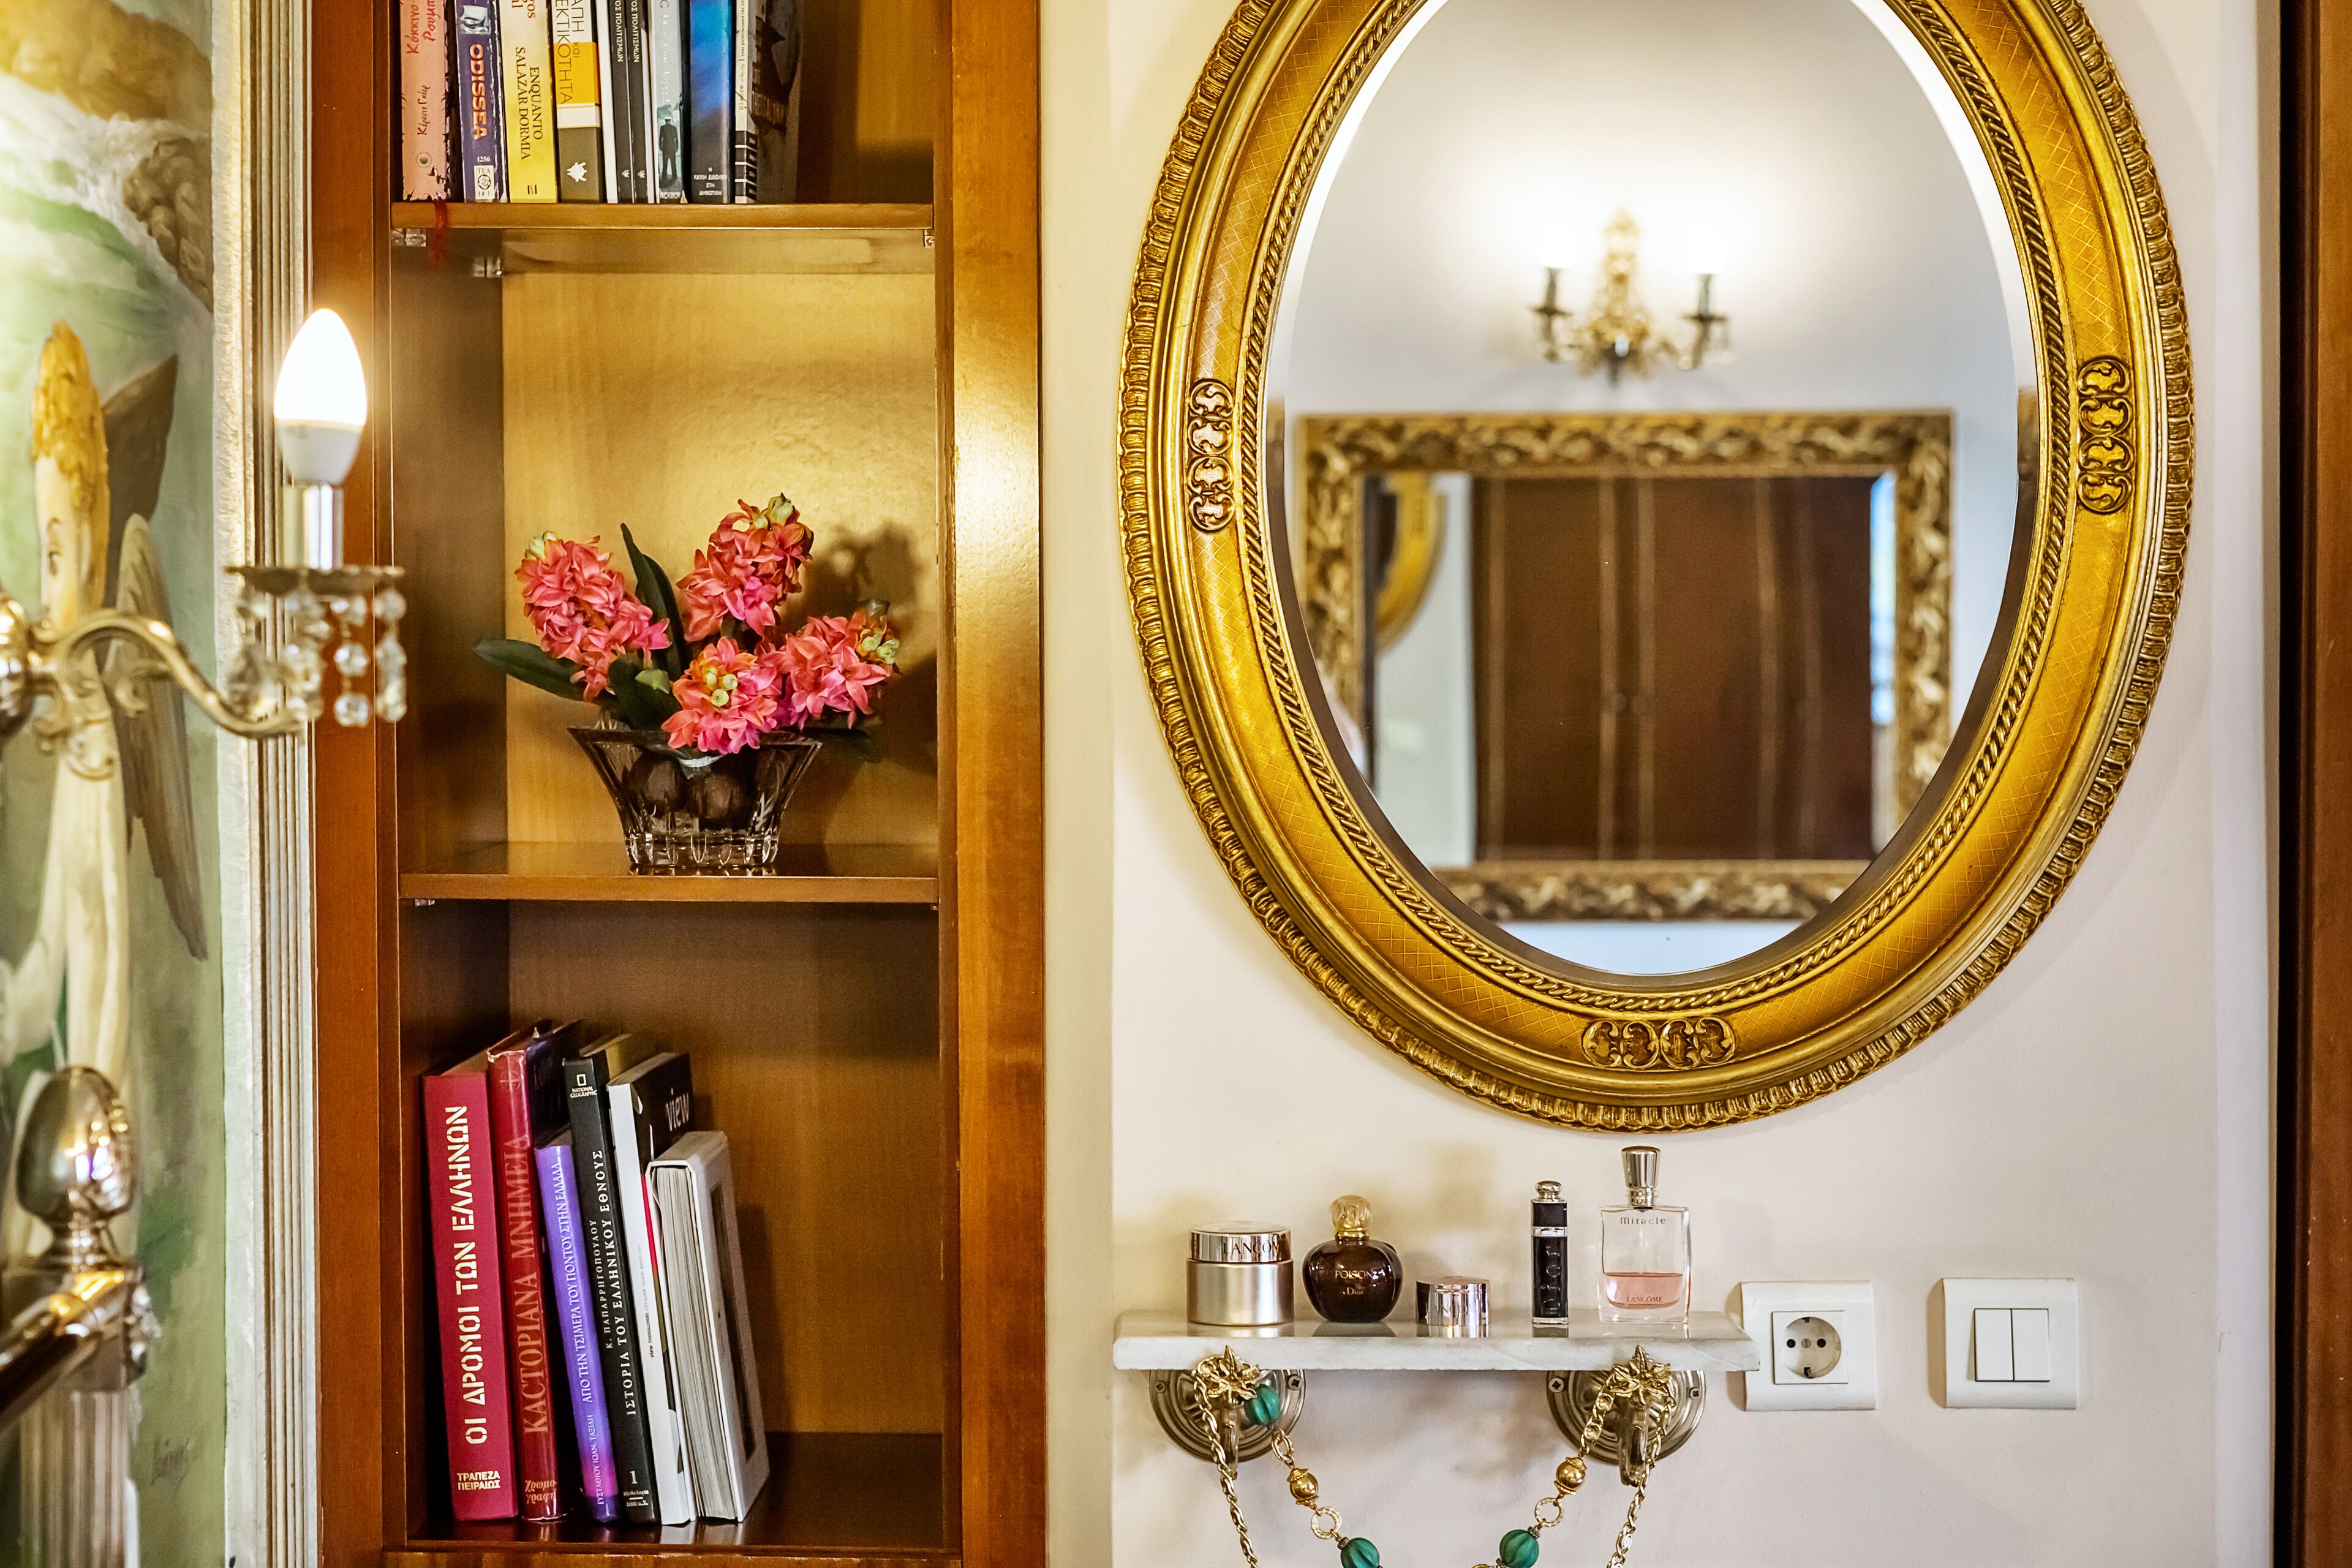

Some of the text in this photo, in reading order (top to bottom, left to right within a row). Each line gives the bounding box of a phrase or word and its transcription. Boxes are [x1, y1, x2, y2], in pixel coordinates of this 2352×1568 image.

[405, 5, 420, 54] Κόκκινο
[470, 43, 488, 140] ODISSEA
[515, 47, 531, 160] SALAZAR DORMIA
[530, 66, 543, 140] ENQUANTO
[570, 1090, 598, 1098] GEOGRAPHIC
[665, 1087, 689, 1131] view
[503, 1135, 535, 1259] ΜΝΗΜΕΙΑ
[557, 1204, 570, 1234] ΣΤΗΝ
[561, 1235, 576, 1282] ΠΟΝΤΟΥ
[1223, 1239, 1280, 1254] LANCÔM
[445, 1106, 488, 1444] ΟΙ ΔΡΟΜΟΙ ΤΩΝ ΕΛΛΗΝΩΝ
[567, 1283, 579, 1305] ΤΟΥ
[589, 1220, 611, 1333] ΠΑΠΑΡΡΗΓΟΠΟΥΛΟΥ
[592, 1150, 636, 1415] ΙΣΤΟΡΙΑ ΤΟΥ ΕΛΛΗΝΙΚΟΥ ΕΘΝΟΥΣ
[1335, 1270, 1373, 1280] POISON
[570, 1306, 586, 1351] ΤΣΙΜΕΡΑ
[576, 1354, 589, 1378] ΤΗΝ
[579, 1379, 593, 1403] ΑΠΟ
[457, 1471, 500, 1482] ΤΡΑΠΕΖΑ
[458, 1480, 501, 1491] ΠΕΙΡΑΙΩΣ
[630, 1470, 638, 1484] 1
